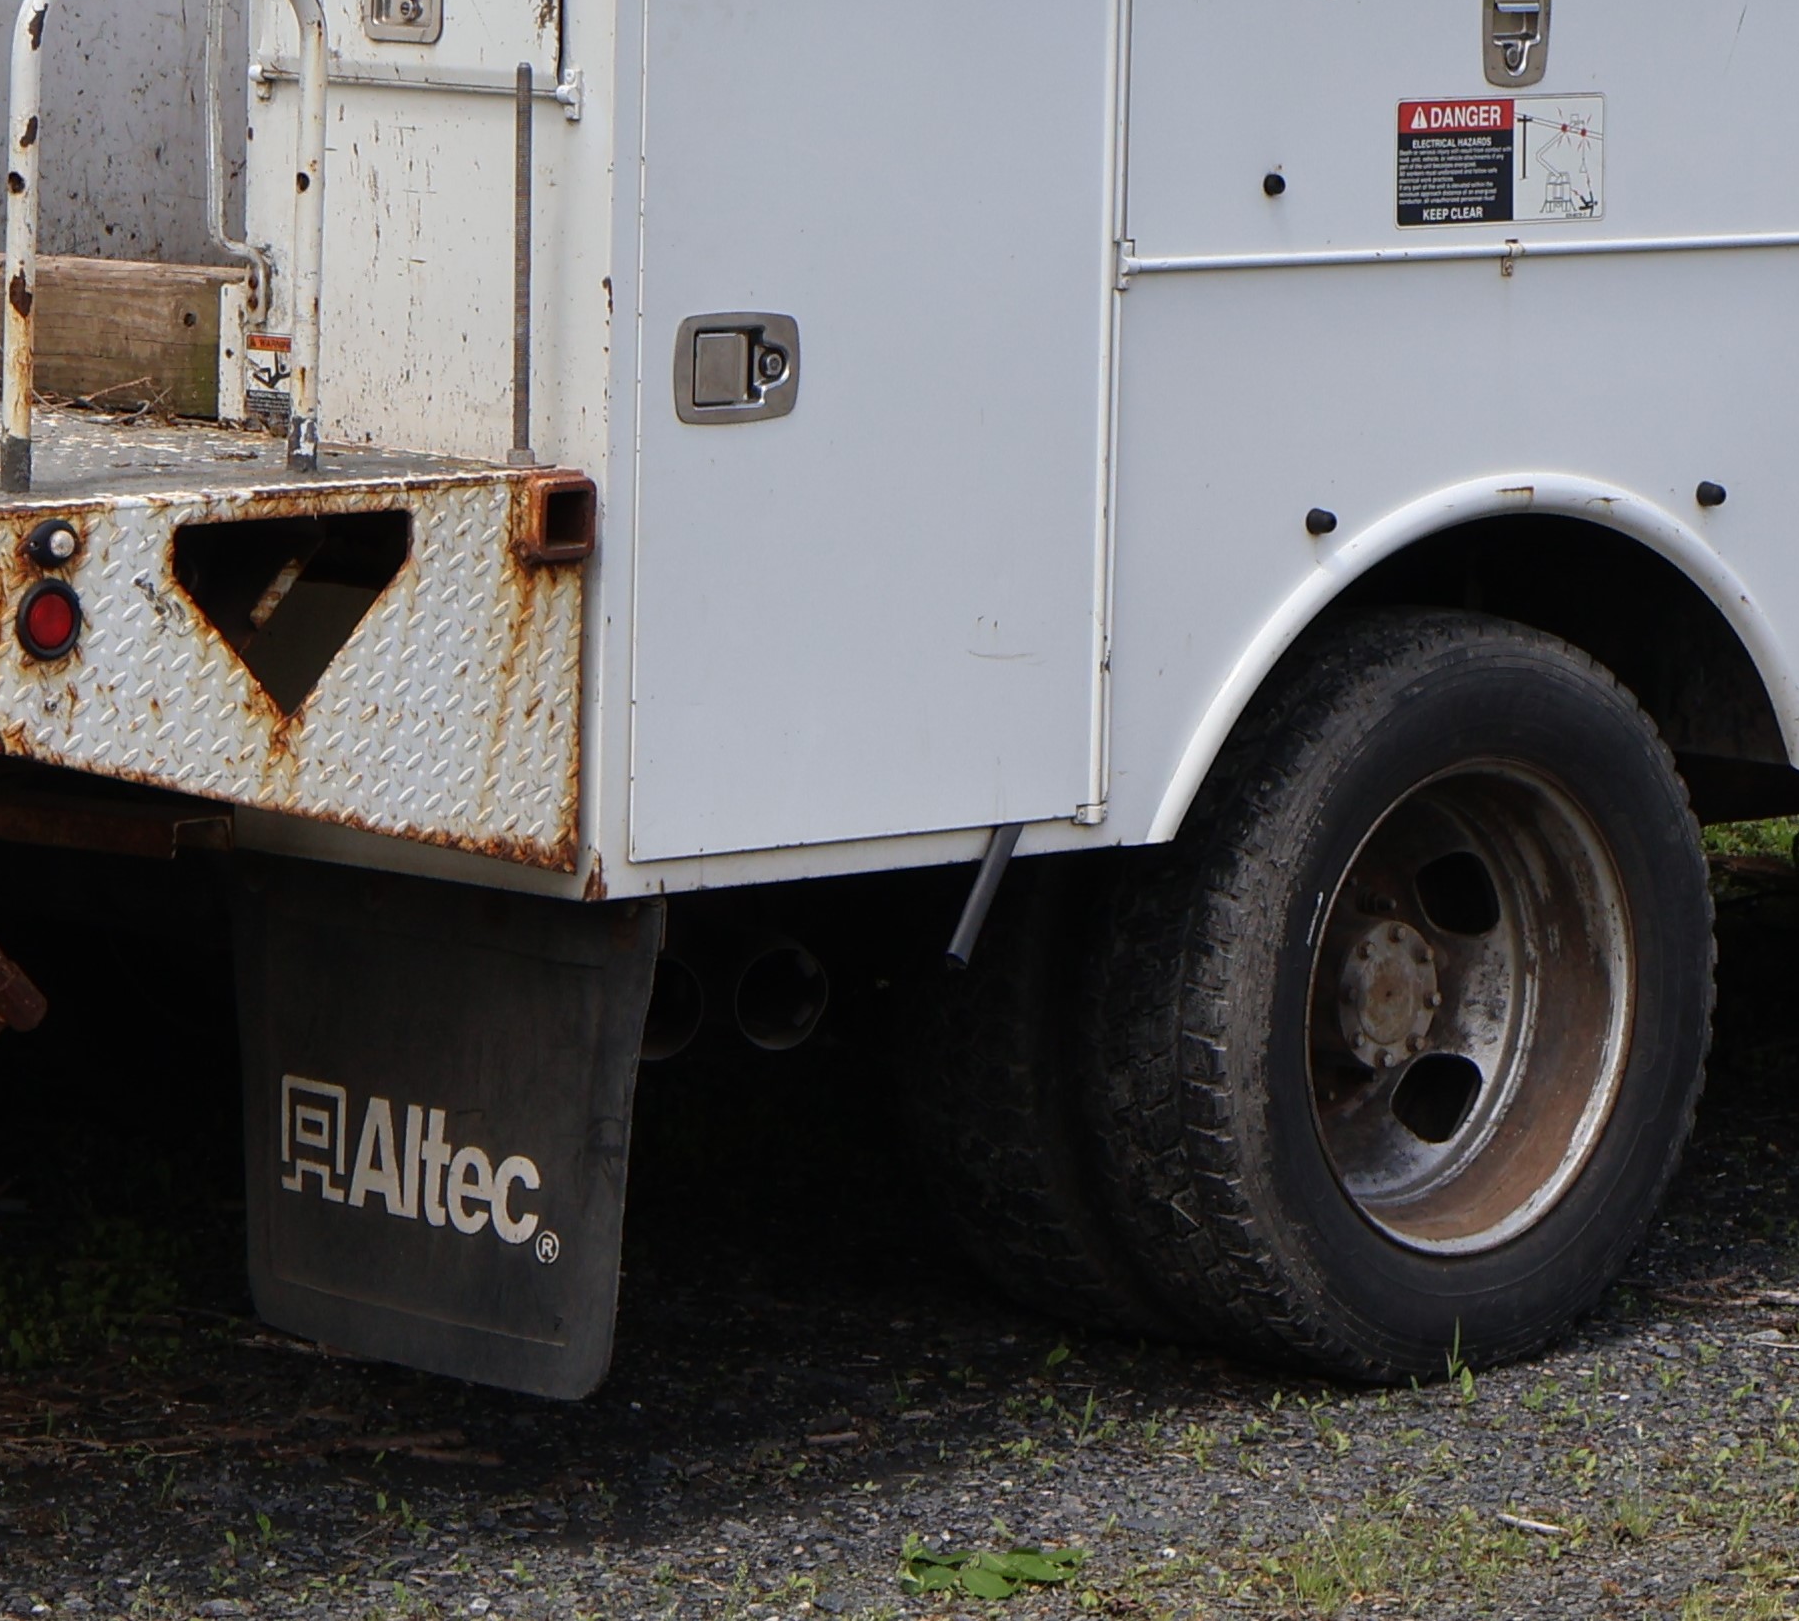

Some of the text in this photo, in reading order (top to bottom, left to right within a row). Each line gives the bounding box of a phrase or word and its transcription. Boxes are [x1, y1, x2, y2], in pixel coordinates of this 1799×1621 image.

[1431, 105, 1501, 128] DANGER
[1412, 137, 1492, 148] ELECTRICAL HAZARDS
[1423, 207, 1483, 220] KEEP CLEAR
[348, 1096, 541, 1245] Altec
